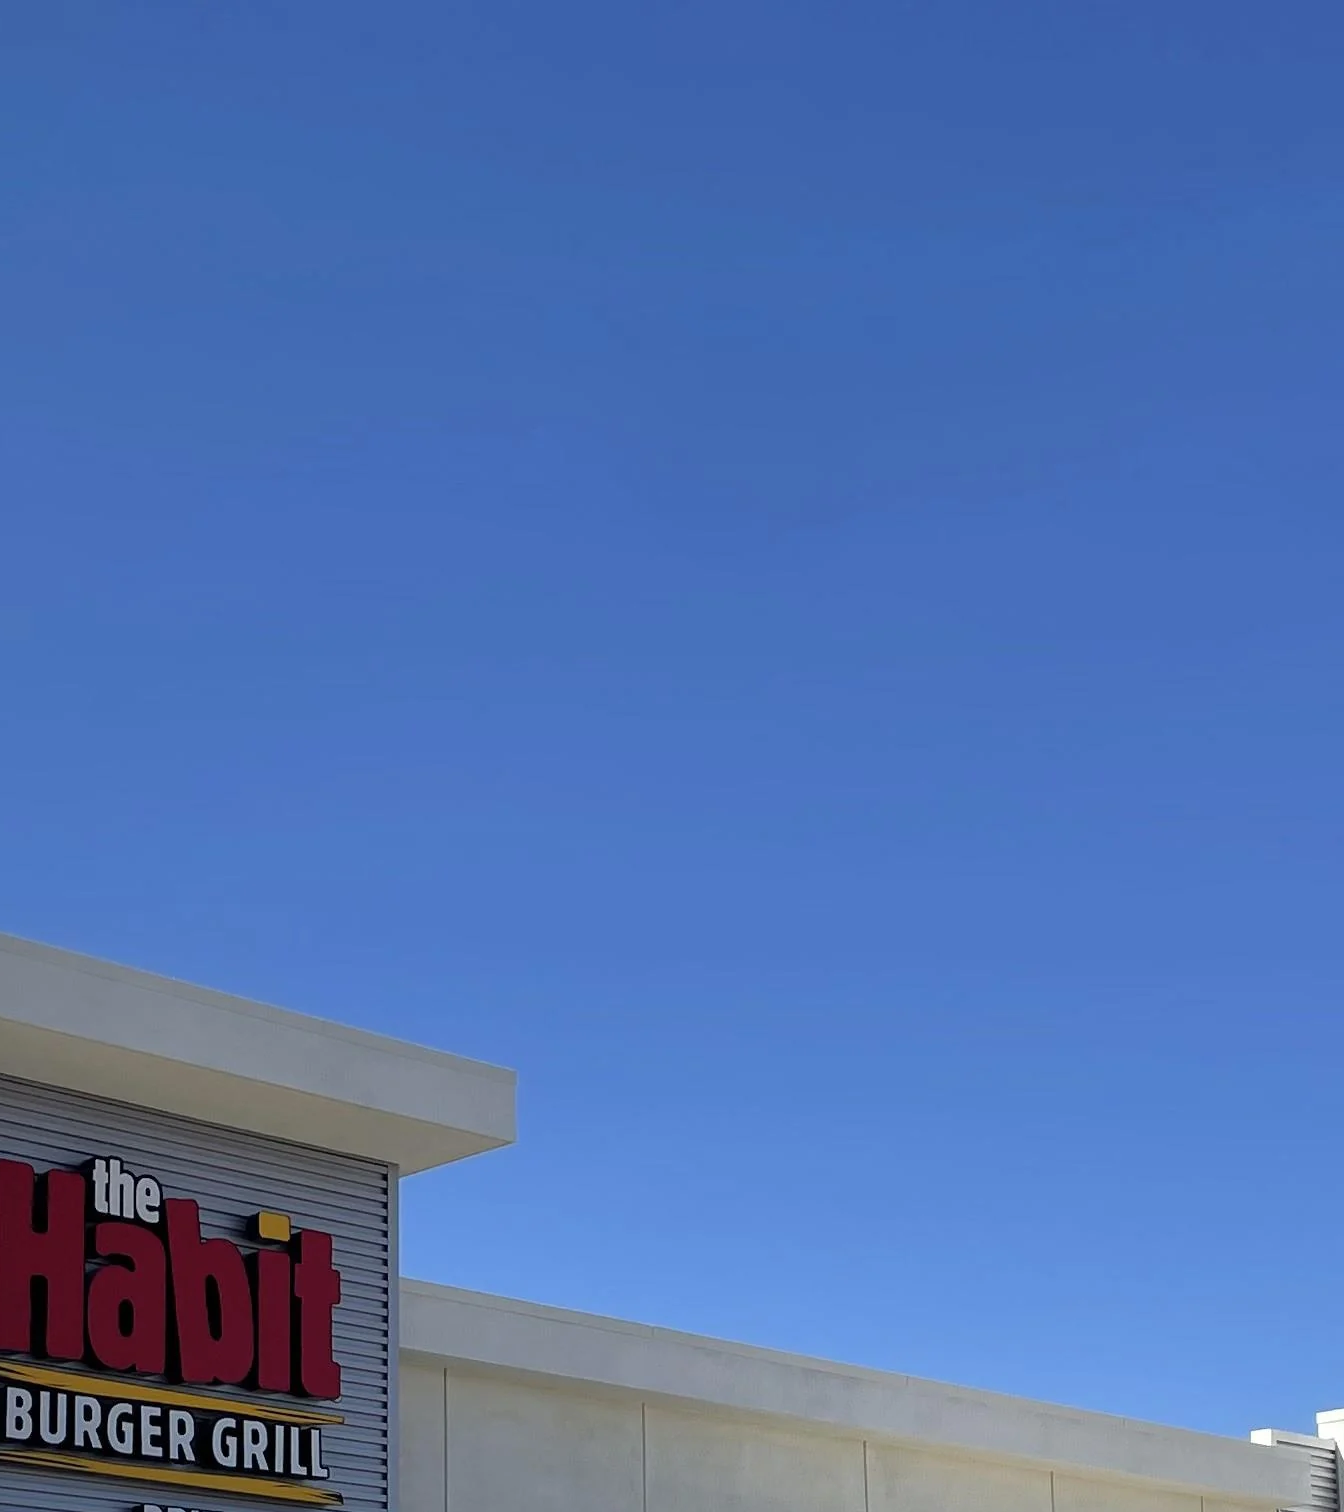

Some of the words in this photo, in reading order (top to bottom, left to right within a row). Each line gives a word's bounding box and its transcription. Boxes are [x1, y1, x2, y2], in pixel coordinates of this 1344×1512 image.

[93, 1158, 160, 1223] the
[6, 1387, 195, 1462] BURGER
[212, 1418, 329, 1478] GRILL
